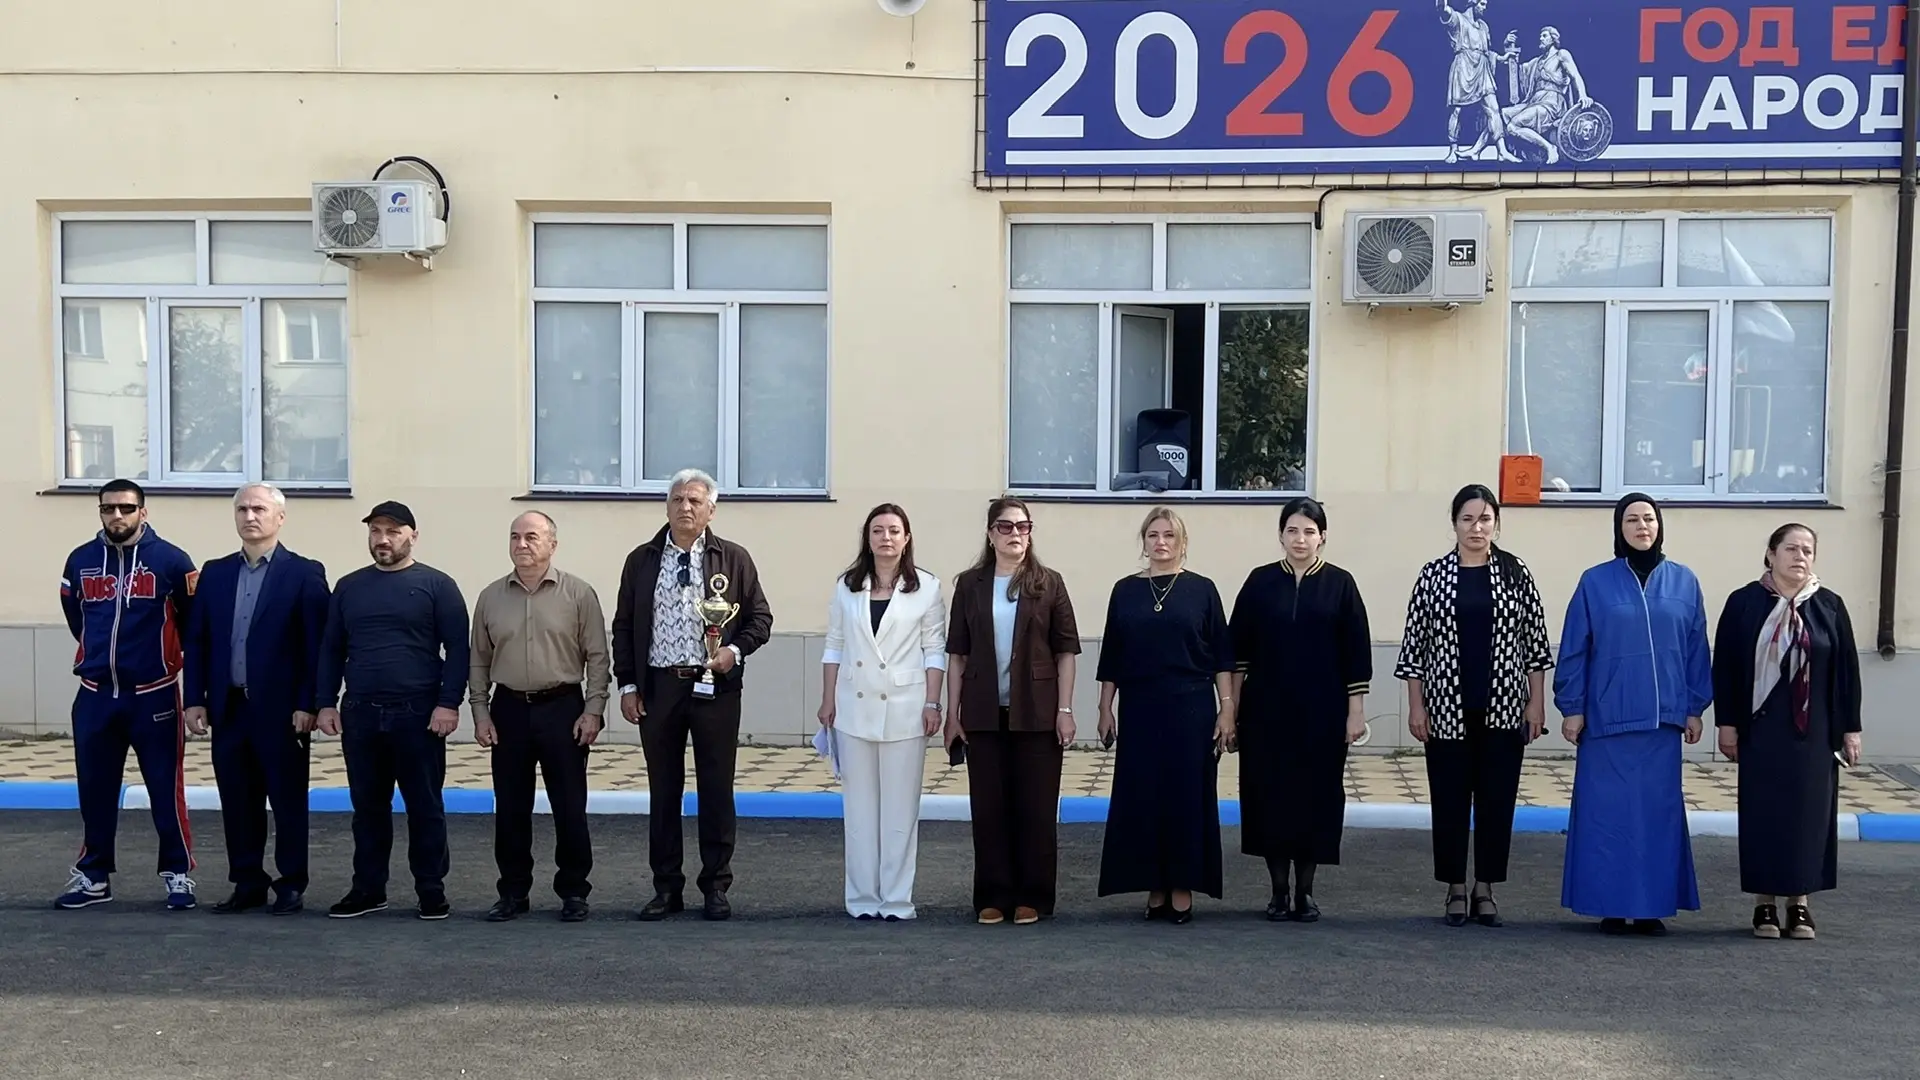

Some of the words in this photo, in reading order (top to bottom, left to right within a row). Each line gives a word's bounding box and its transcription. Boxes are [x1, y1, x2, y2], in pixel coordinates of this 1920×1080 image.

[1639, 7, 1799, 67] ГОД
[1005, 10, 1414, 139] 2026
[1637, 74, 1904, 134] НАРОД
[387, 206, 412, 214] GREE
[1160, 451, 1185, 460] 1000
